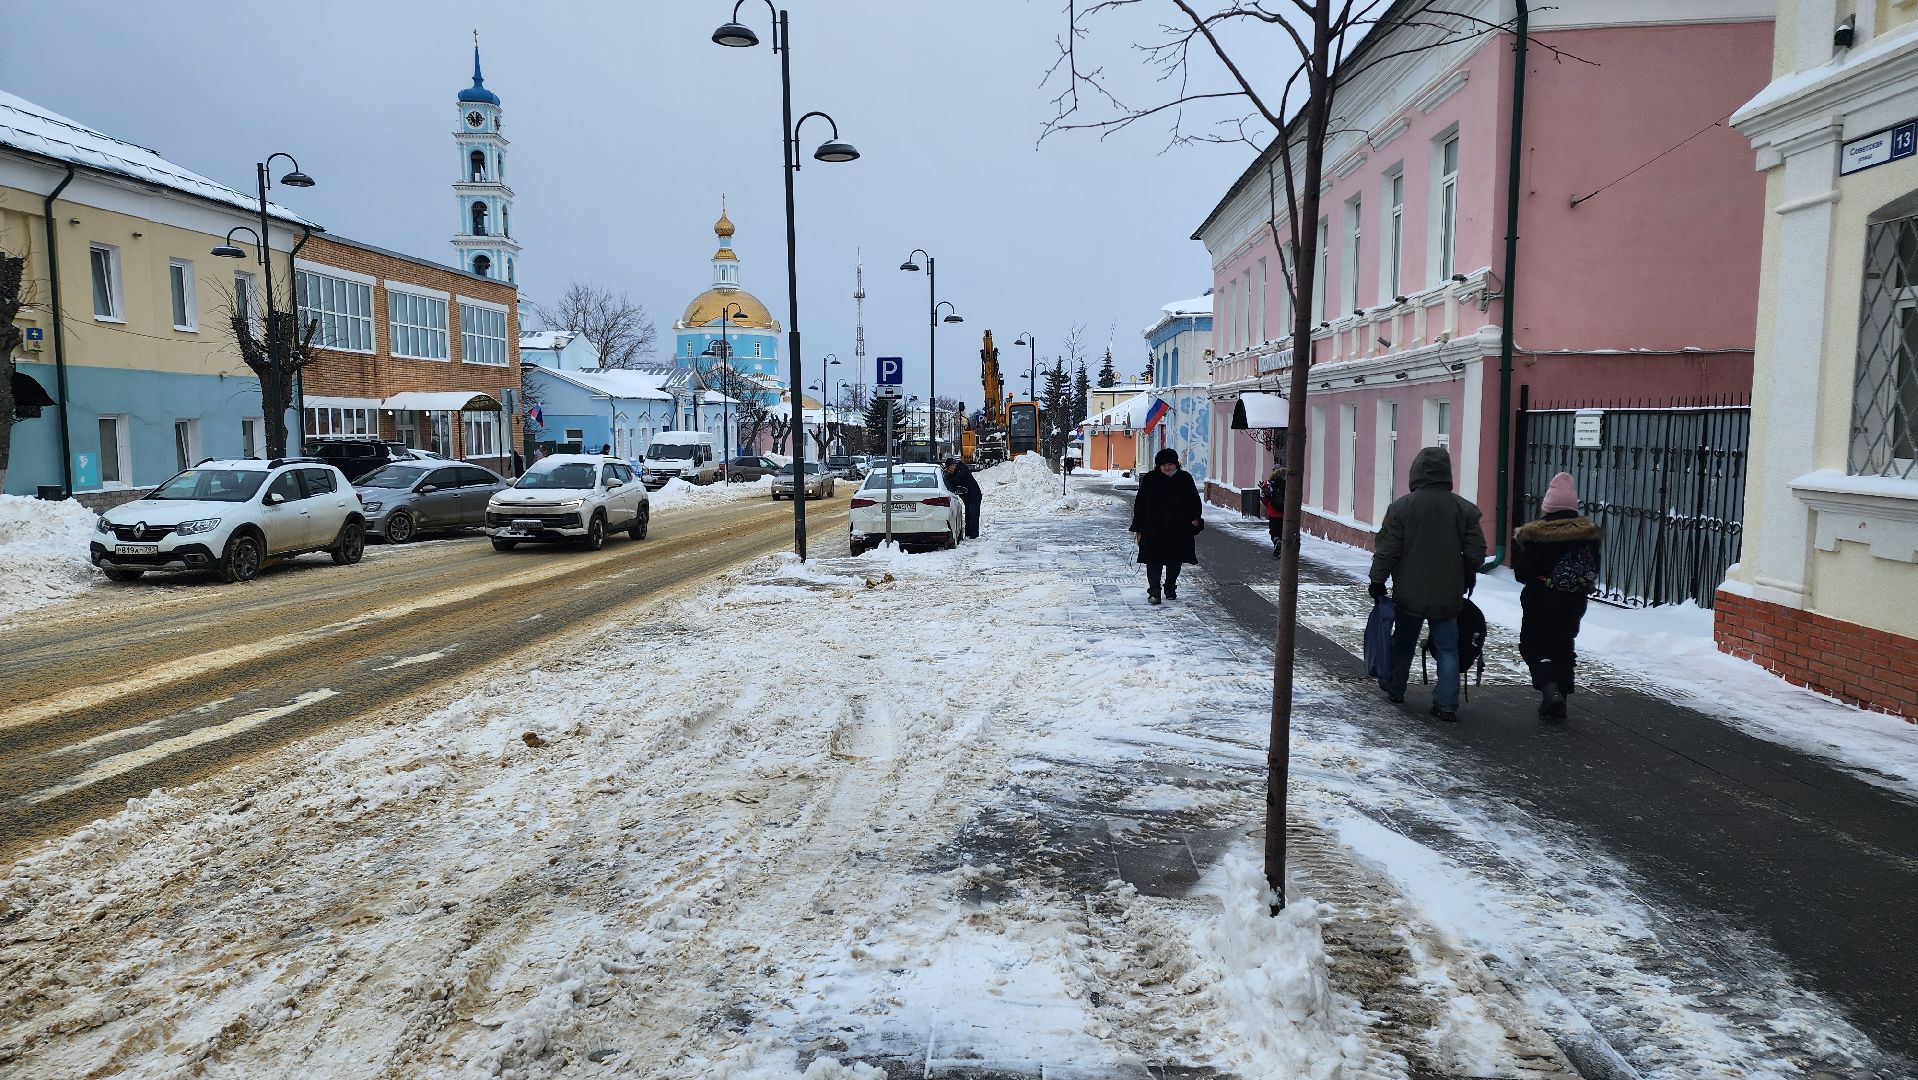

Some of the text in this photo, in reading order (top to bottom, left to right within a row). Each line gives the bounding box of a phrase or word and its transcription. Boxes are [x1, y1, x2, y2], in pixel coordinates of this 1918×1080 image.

[1850, 140, 1883, 155] Советская
[1897, 132, 1911, 149] 13
[1858, 154, 1873, 162] улица
[882, 360, 898, 382] P
